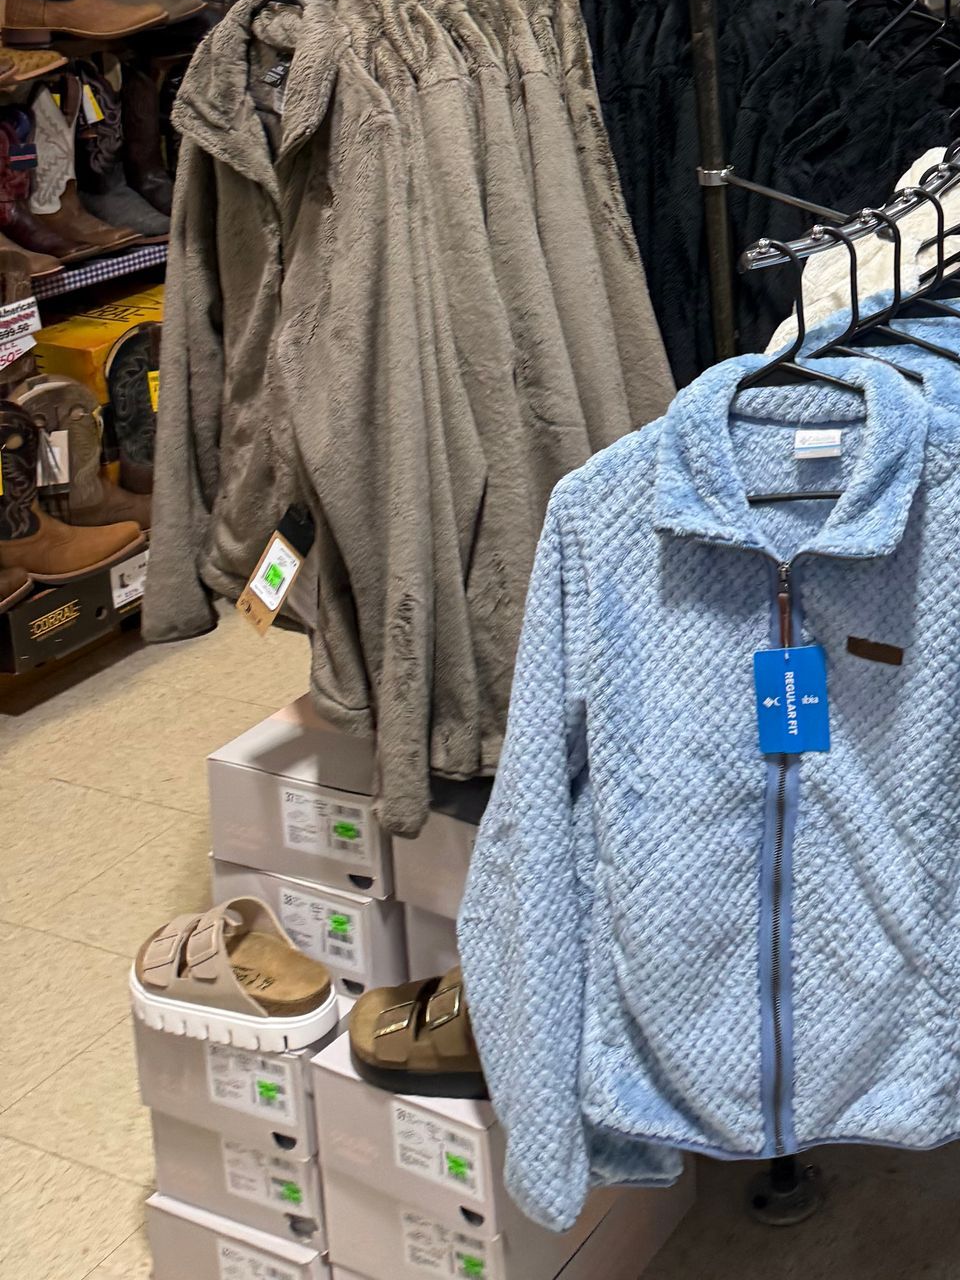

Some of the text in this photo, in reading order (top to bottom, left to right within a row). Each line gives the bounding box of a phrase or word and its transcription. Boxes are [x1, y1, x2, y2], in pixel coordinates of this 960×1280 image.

[33, 603, 77, 635] CORRAL
[784, 671, 799, 736] REGULAR FIT
